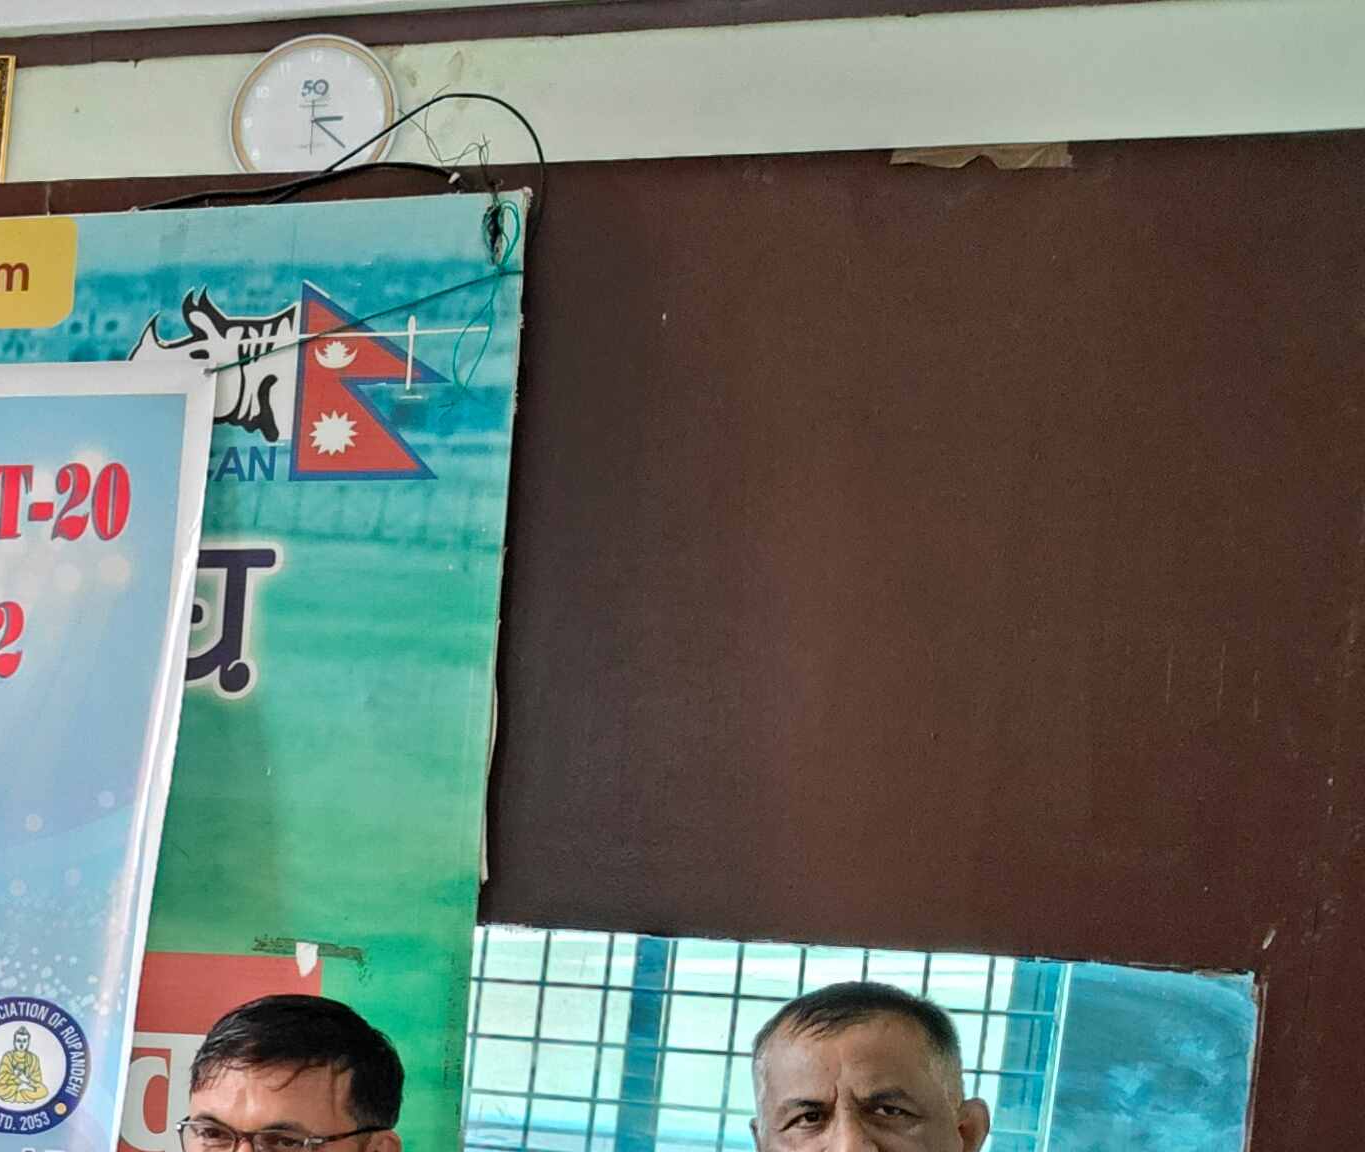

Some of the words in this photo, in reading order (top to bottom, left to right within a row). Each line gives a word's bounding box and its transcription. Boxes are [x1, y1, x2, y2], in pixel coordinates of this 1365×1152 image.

[207, 446, 277, 482] AN
[48, 1012, 67, 1030] OF
[61, 1026, 86, 1098] RUPANDEHI
[20, 1111, 50, 1131] 2053
